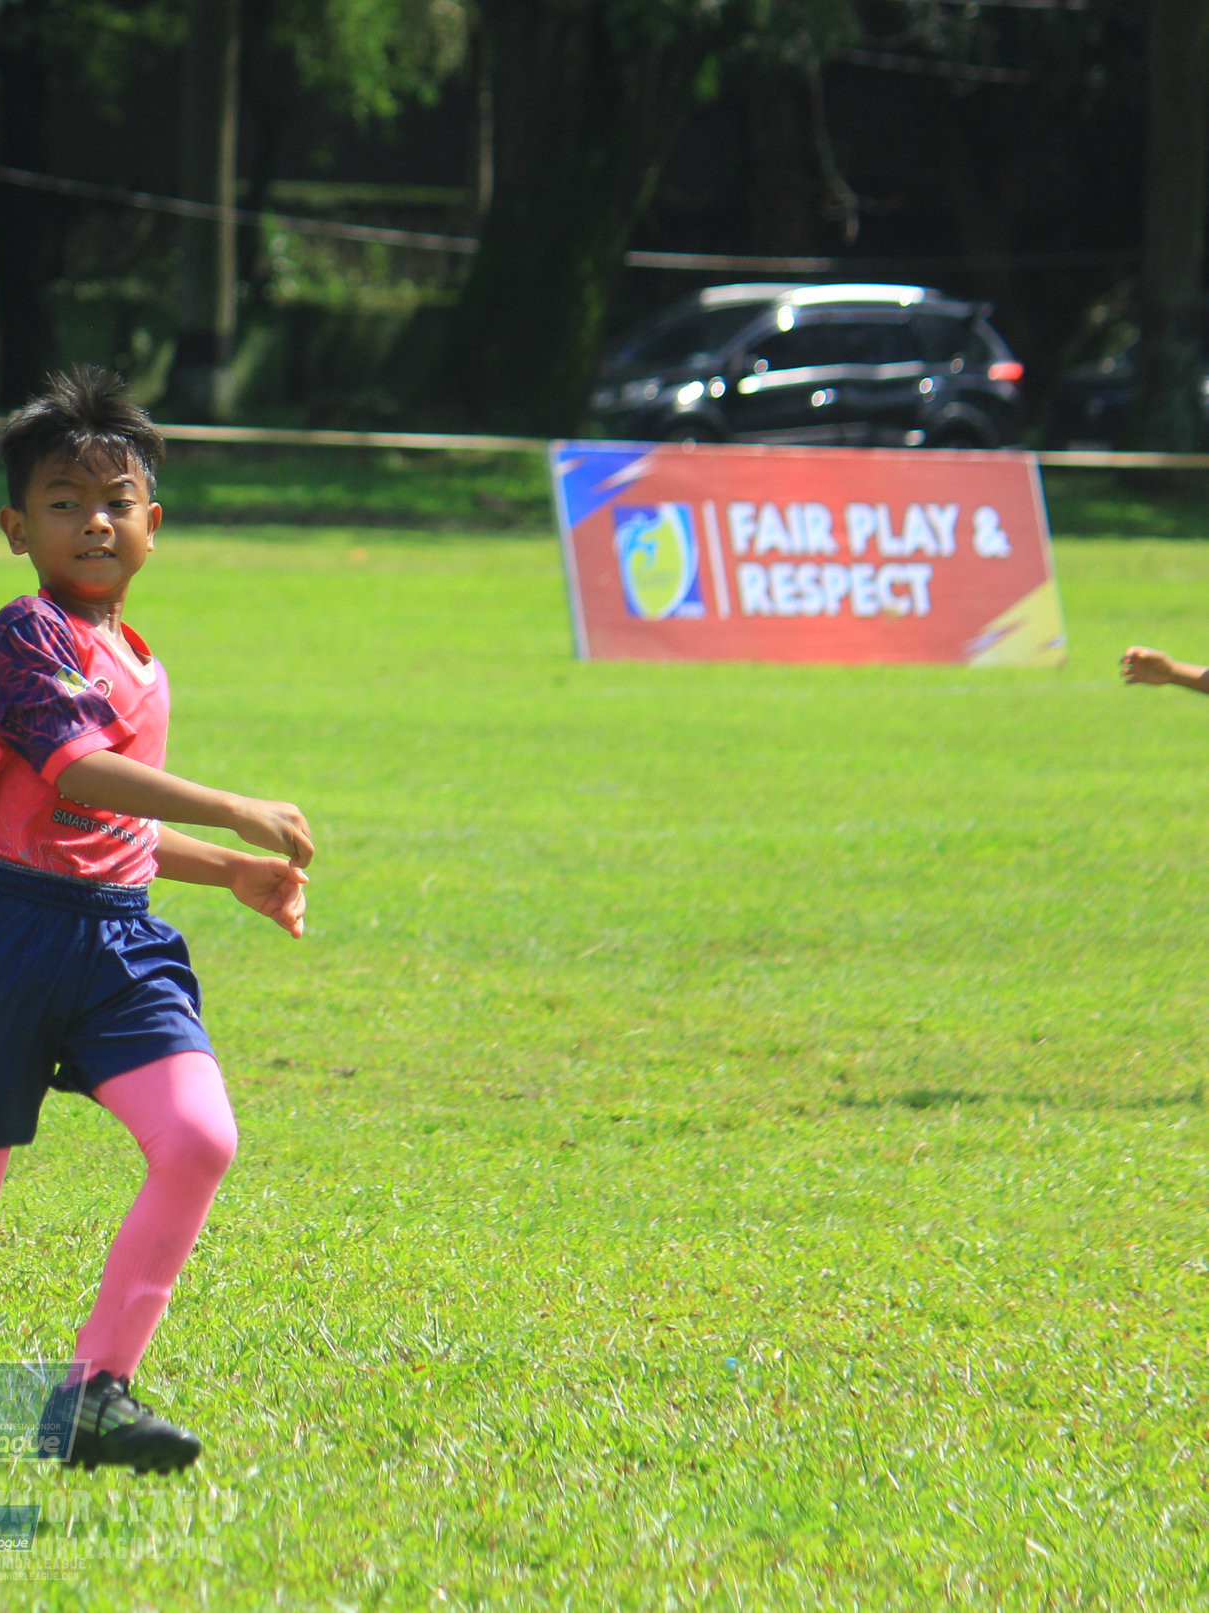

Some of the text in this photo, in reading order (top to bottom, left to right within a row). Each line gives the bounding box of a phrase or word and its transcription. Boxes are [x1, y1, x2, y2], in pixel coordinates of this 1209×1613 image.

[727, 502, 1011, 558] FAIR PLAY &
[738, 562, 933, 617] RESPECT
[52, 808, 97, 833] SMART
